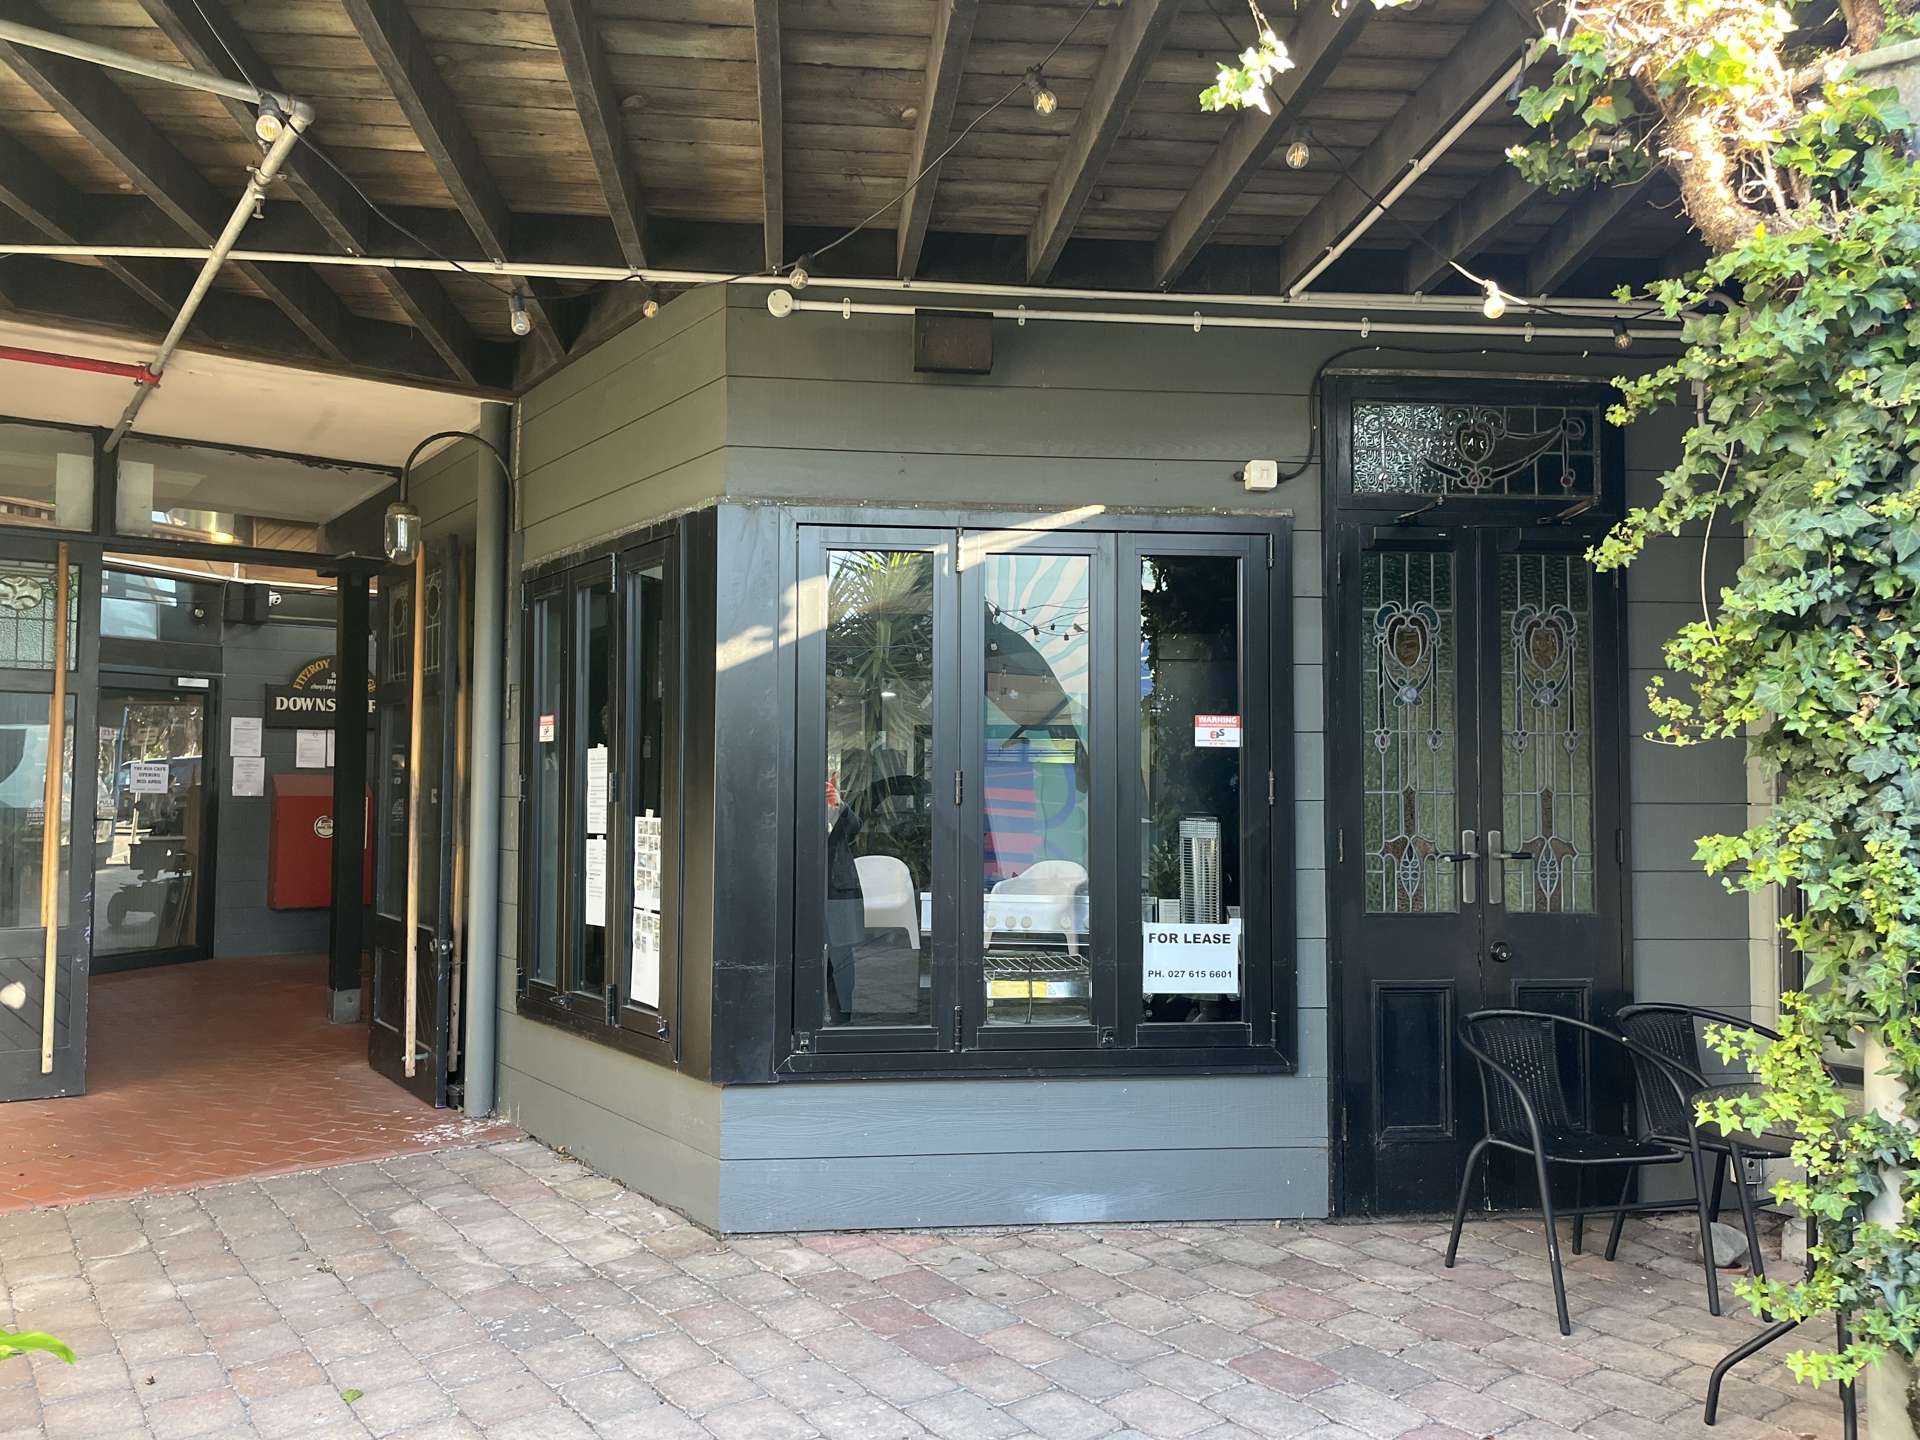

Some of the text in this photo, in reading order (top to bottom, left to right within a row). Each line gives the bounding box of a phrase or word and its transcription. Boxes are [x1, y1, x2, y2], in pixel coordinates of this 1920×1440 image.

[293, 659, 330, 689] FITZROY
[1148, 933, 1232, 944] FOR LEASE
[1148, 970, 1232, 978] PH. 027 615 6601
